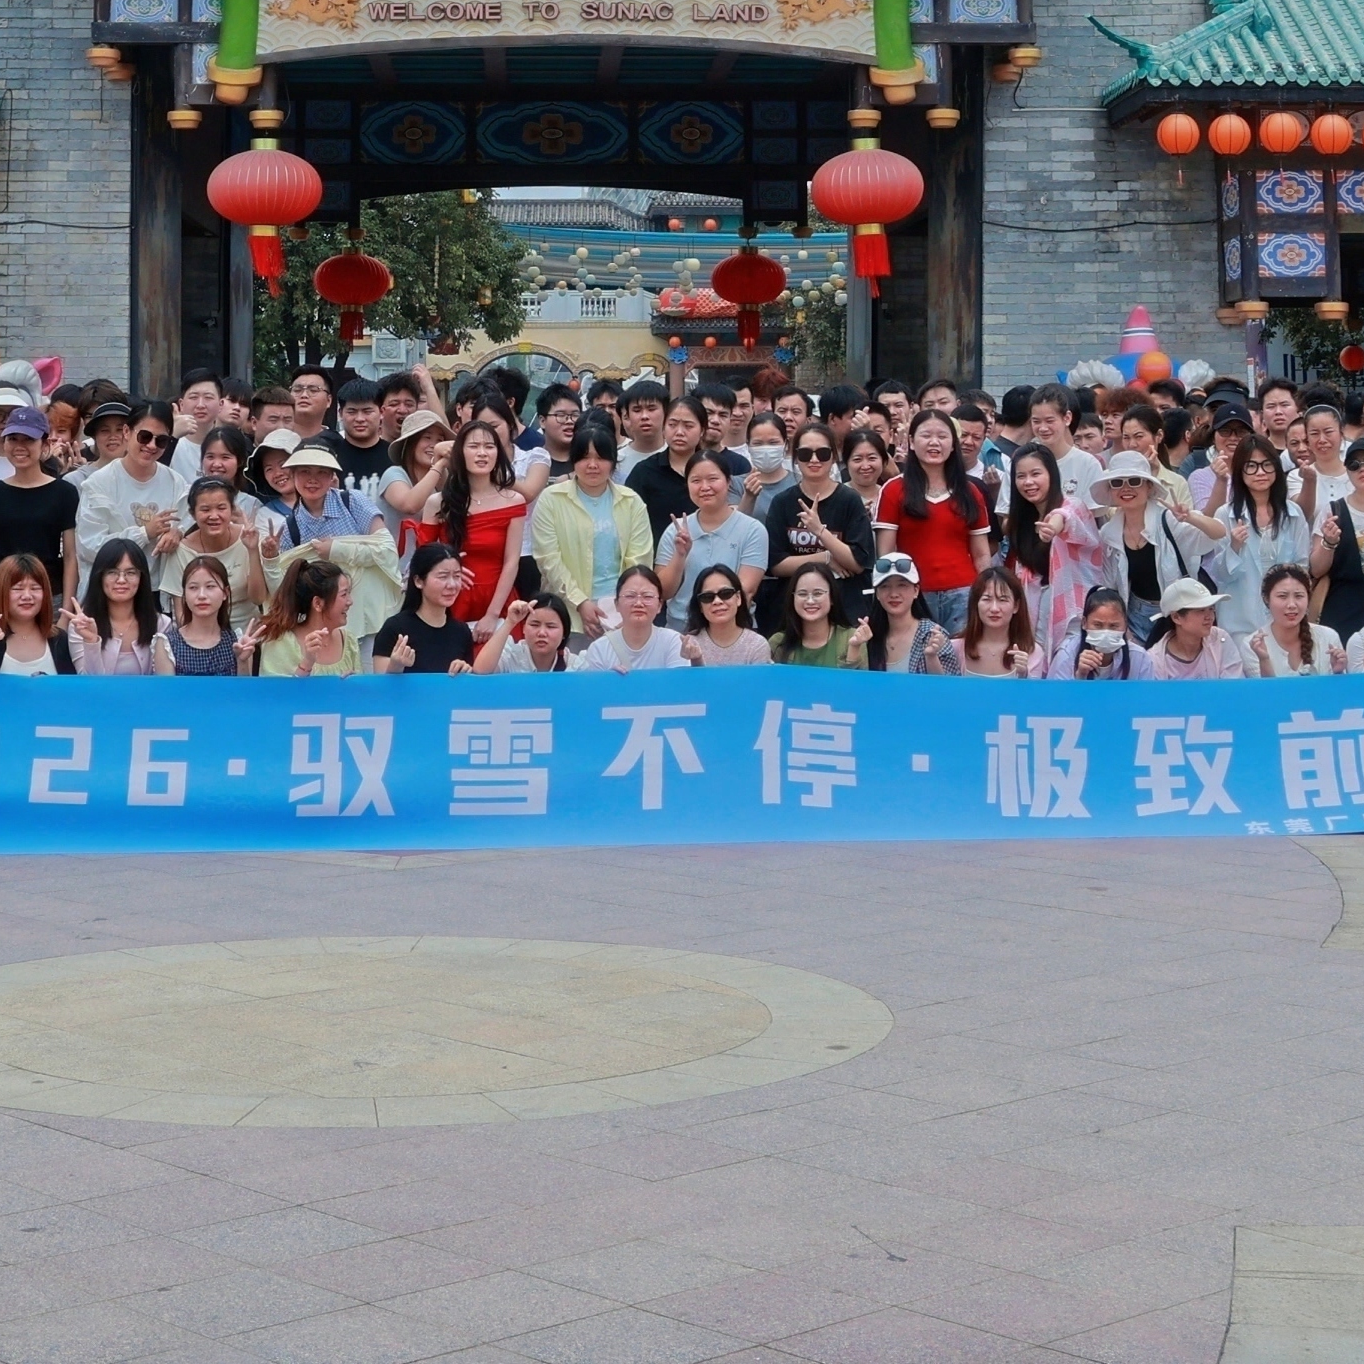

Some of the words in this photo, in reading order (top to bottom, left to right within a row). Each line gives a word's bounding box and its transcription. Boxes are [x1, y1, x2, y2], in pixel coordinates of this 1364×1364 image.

[368, 0, 503, 23] WELCOME
[524, 0, 561, 21] TO
[579, 0, 675, 22] SUNAC
[691, 3, 771, 24] LAND
